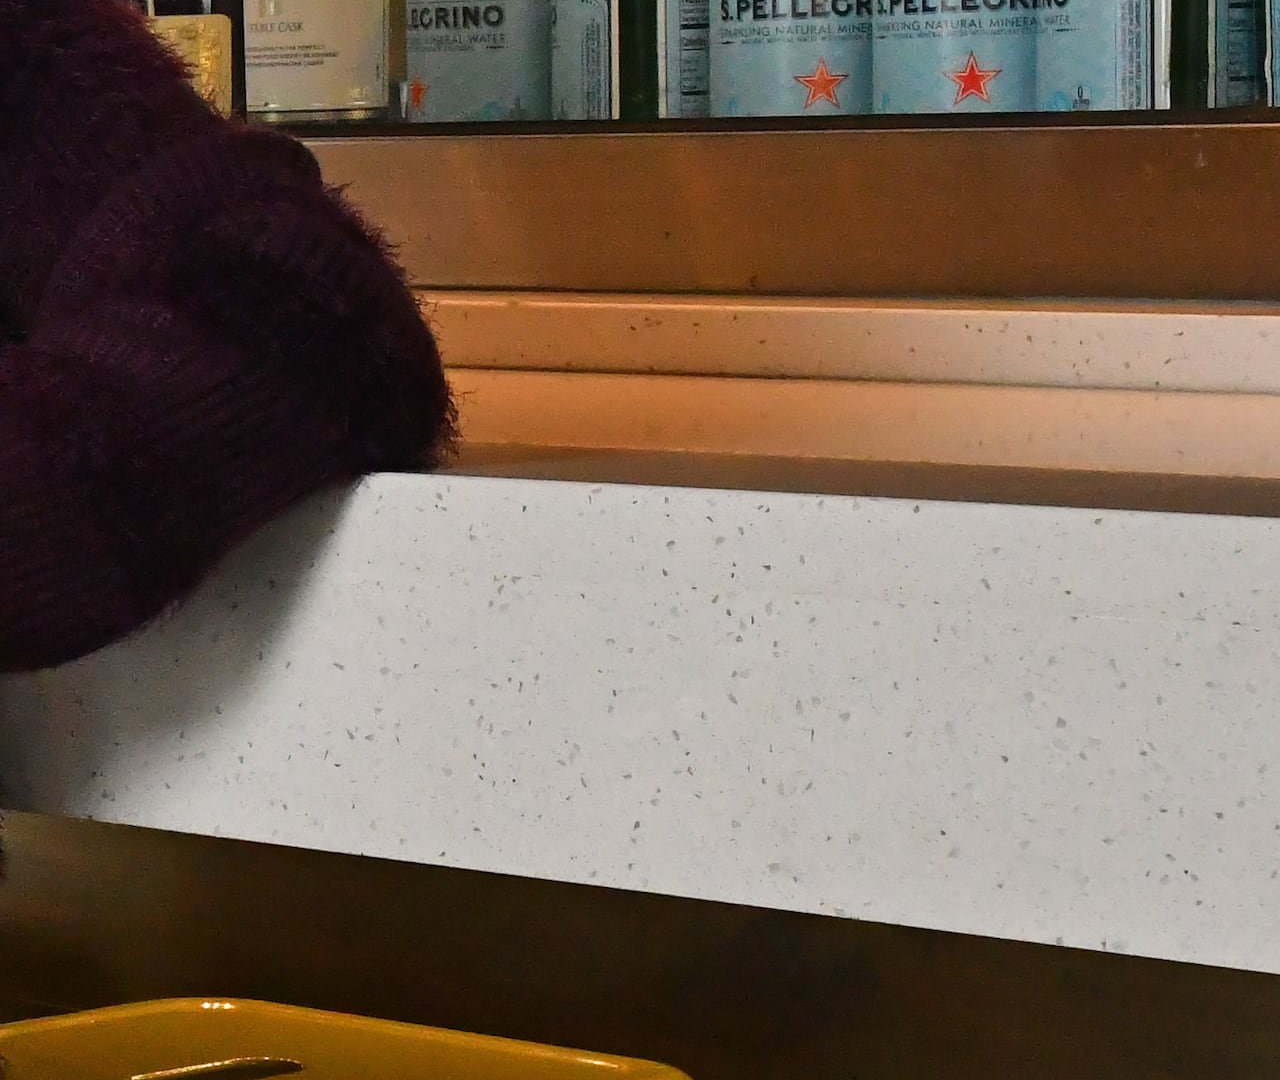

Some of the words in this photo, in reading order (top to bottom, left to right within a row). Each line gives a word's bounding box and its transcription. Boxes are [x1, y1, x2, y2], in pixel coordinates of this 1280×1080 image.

[411, 6, 504, 30] EGRINO
[924, 18, 983, 31] NATURAL
[989, 17, 1037, 29] MINERA
[775, 24, 832, 36] NATURAL
